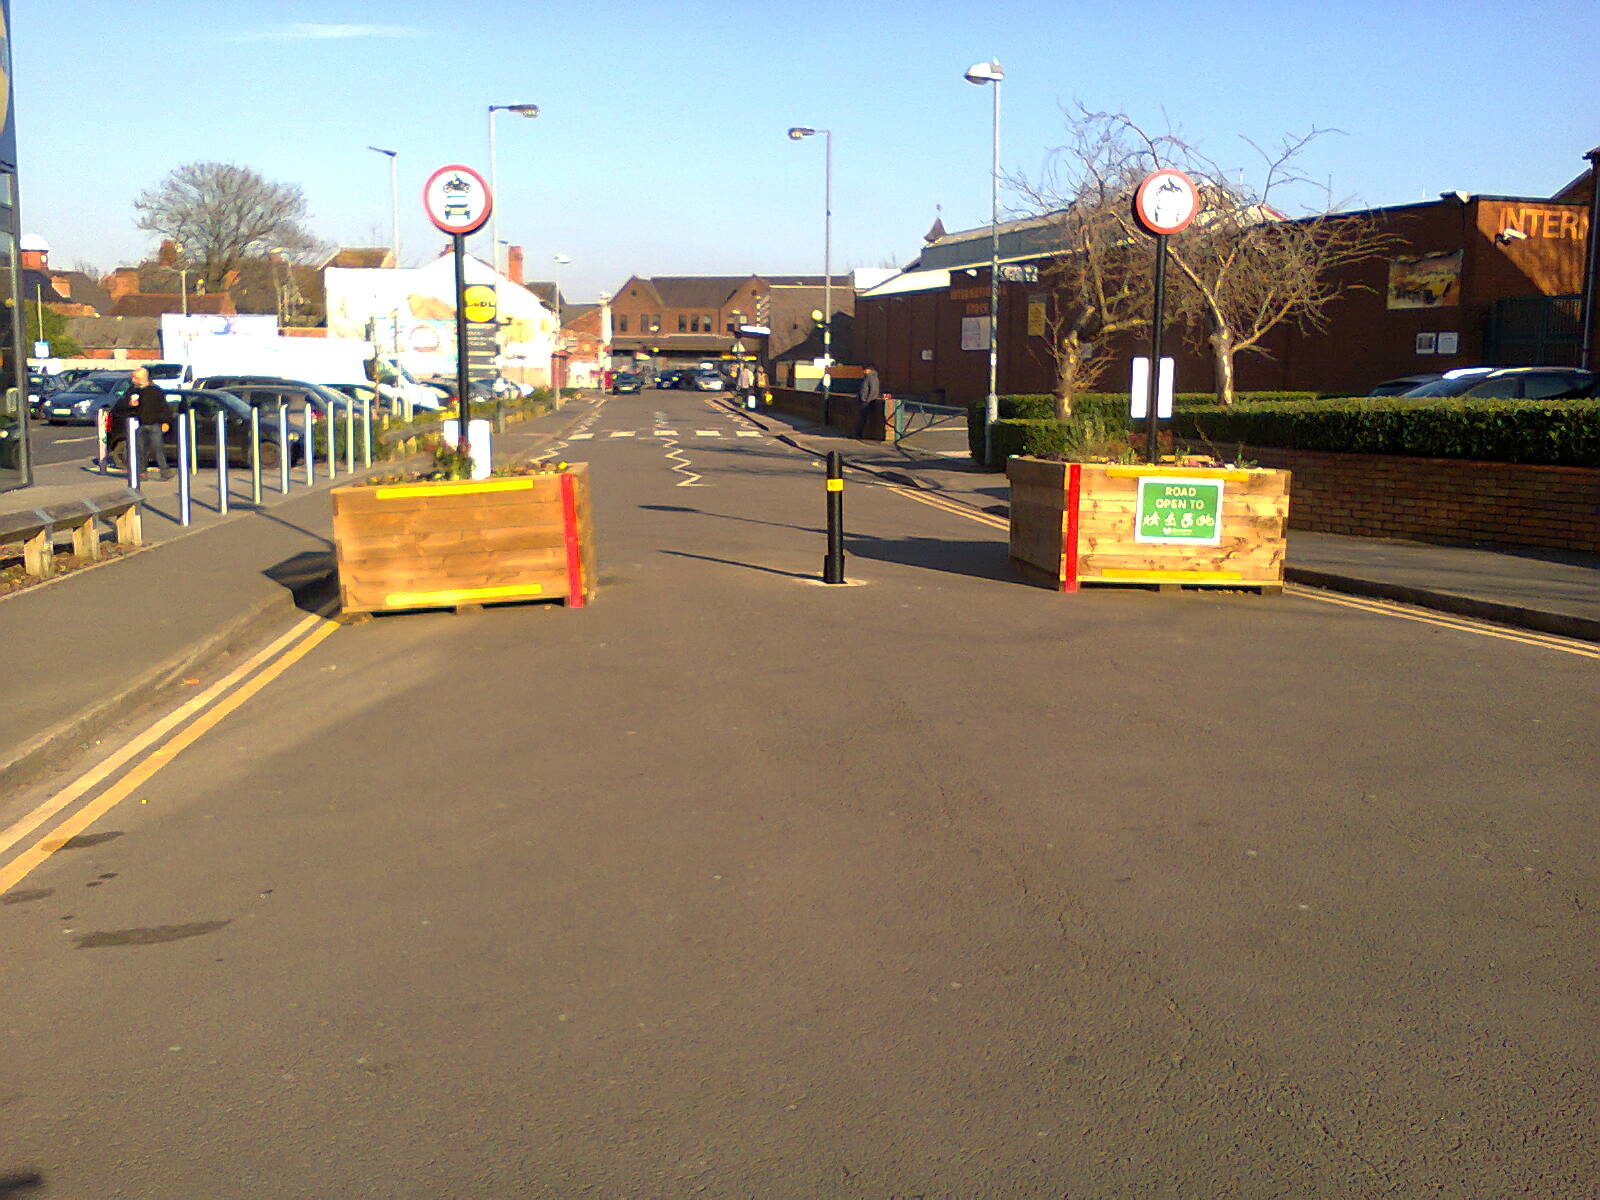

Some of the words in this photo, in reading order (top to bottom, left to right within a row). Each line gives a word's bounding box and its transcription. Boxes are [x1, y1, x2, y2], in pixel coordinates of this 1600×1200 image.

[1165, 487, 1197, 497] ROAD
[1155, 498, 1187, 509] OPEN
[1190, 499, 1204, 510] TO
